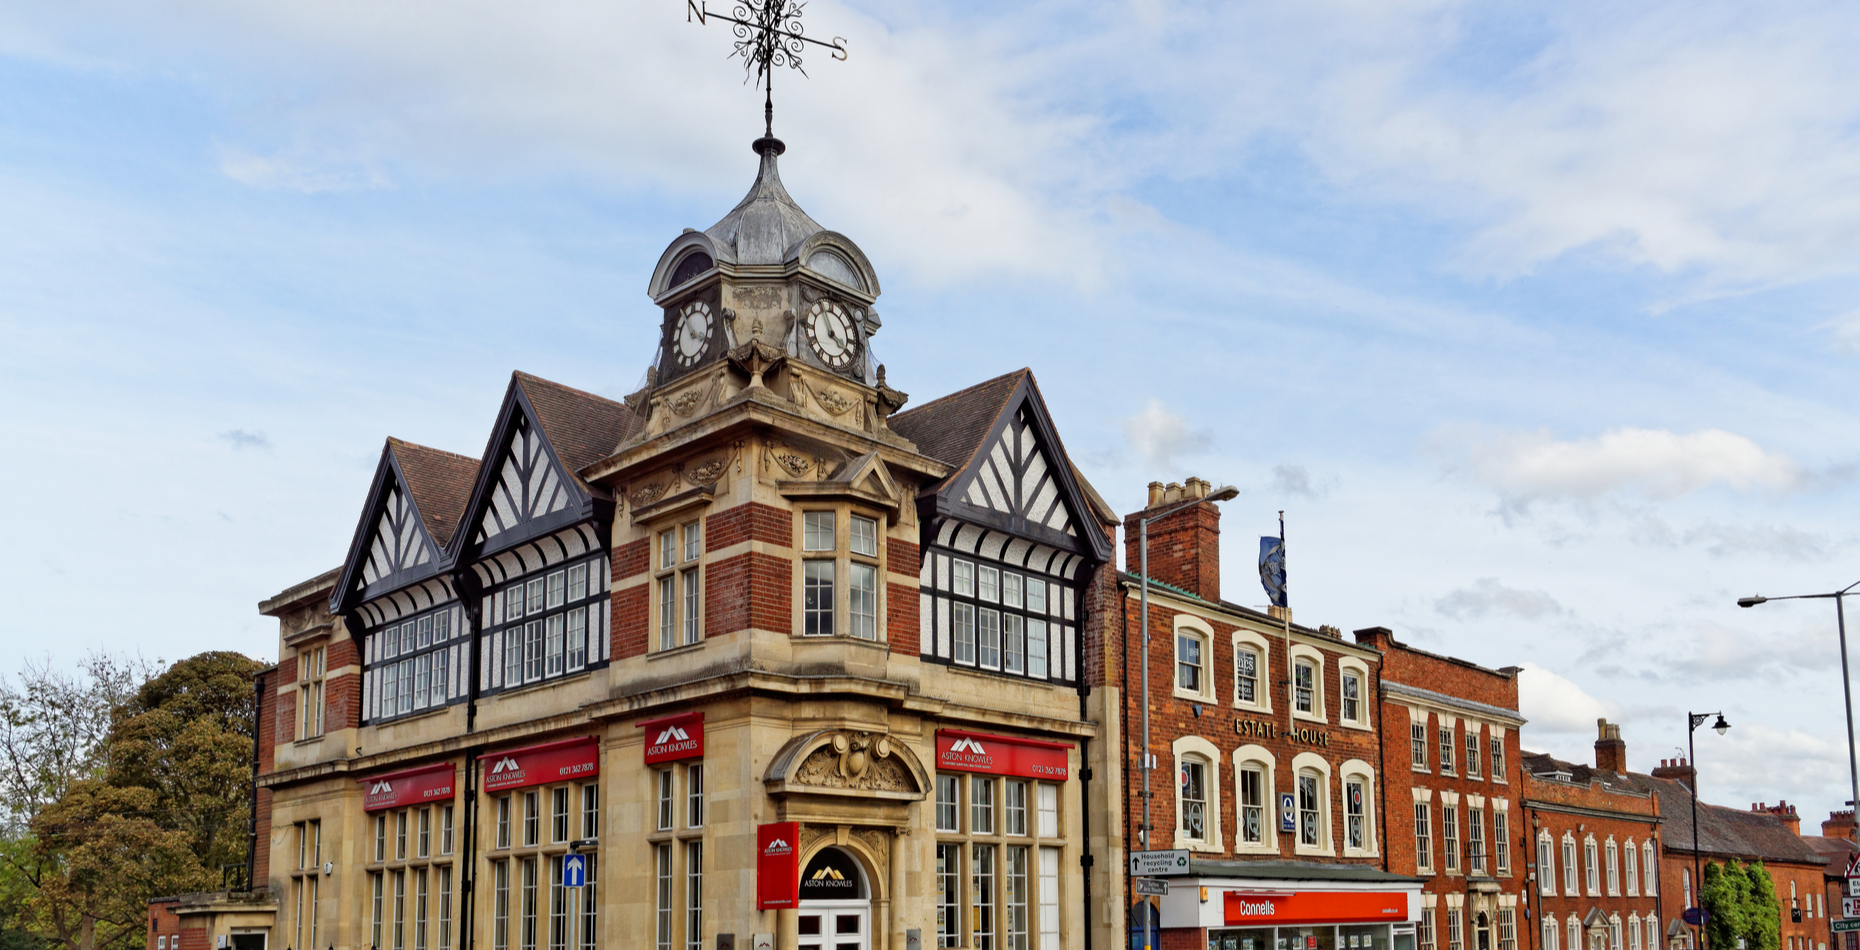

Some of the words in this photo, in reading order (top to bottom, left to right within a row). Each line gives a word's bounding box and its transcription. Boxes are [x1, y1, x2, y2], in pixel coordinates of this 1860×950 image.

[831, 36, 848, 62] S
[1235, 718, 1277, 738] ESTATE
[1292, 727, 1329, 746] HOUSE
[647, 744, 667, 756] ASTON
[668, 739, 698, 752] KNOWLES
[941, 751, 962, 761] ASTON
[964, 754, 993, 765] KNOWLES
[559, 766, 571, 776] 0121
[571, 764, 582, 774] 362
[581, 762, 594, 772] 7878
[1032, 764, 1044, 773] 0121
[1045, 765, 1054, 774] 362
[1054, 767, 1067, 776] 7878
[485, 773, 502, 784] ASTON
[502, 769, 526, 780] KNOWLES
[423, 789, 433, 798] 0121
[1283, 797, 1295, 824] Q
[1141, 852, 1175, 860] Household
[1143, 859, 1173, 867] recycling
[804, 879, 824, 888] ASTON
[825, 879, 853, 888] KNOWLES
[1239, 899, 1276, 916] Connells
[1835, 922, 1849, 930] City
